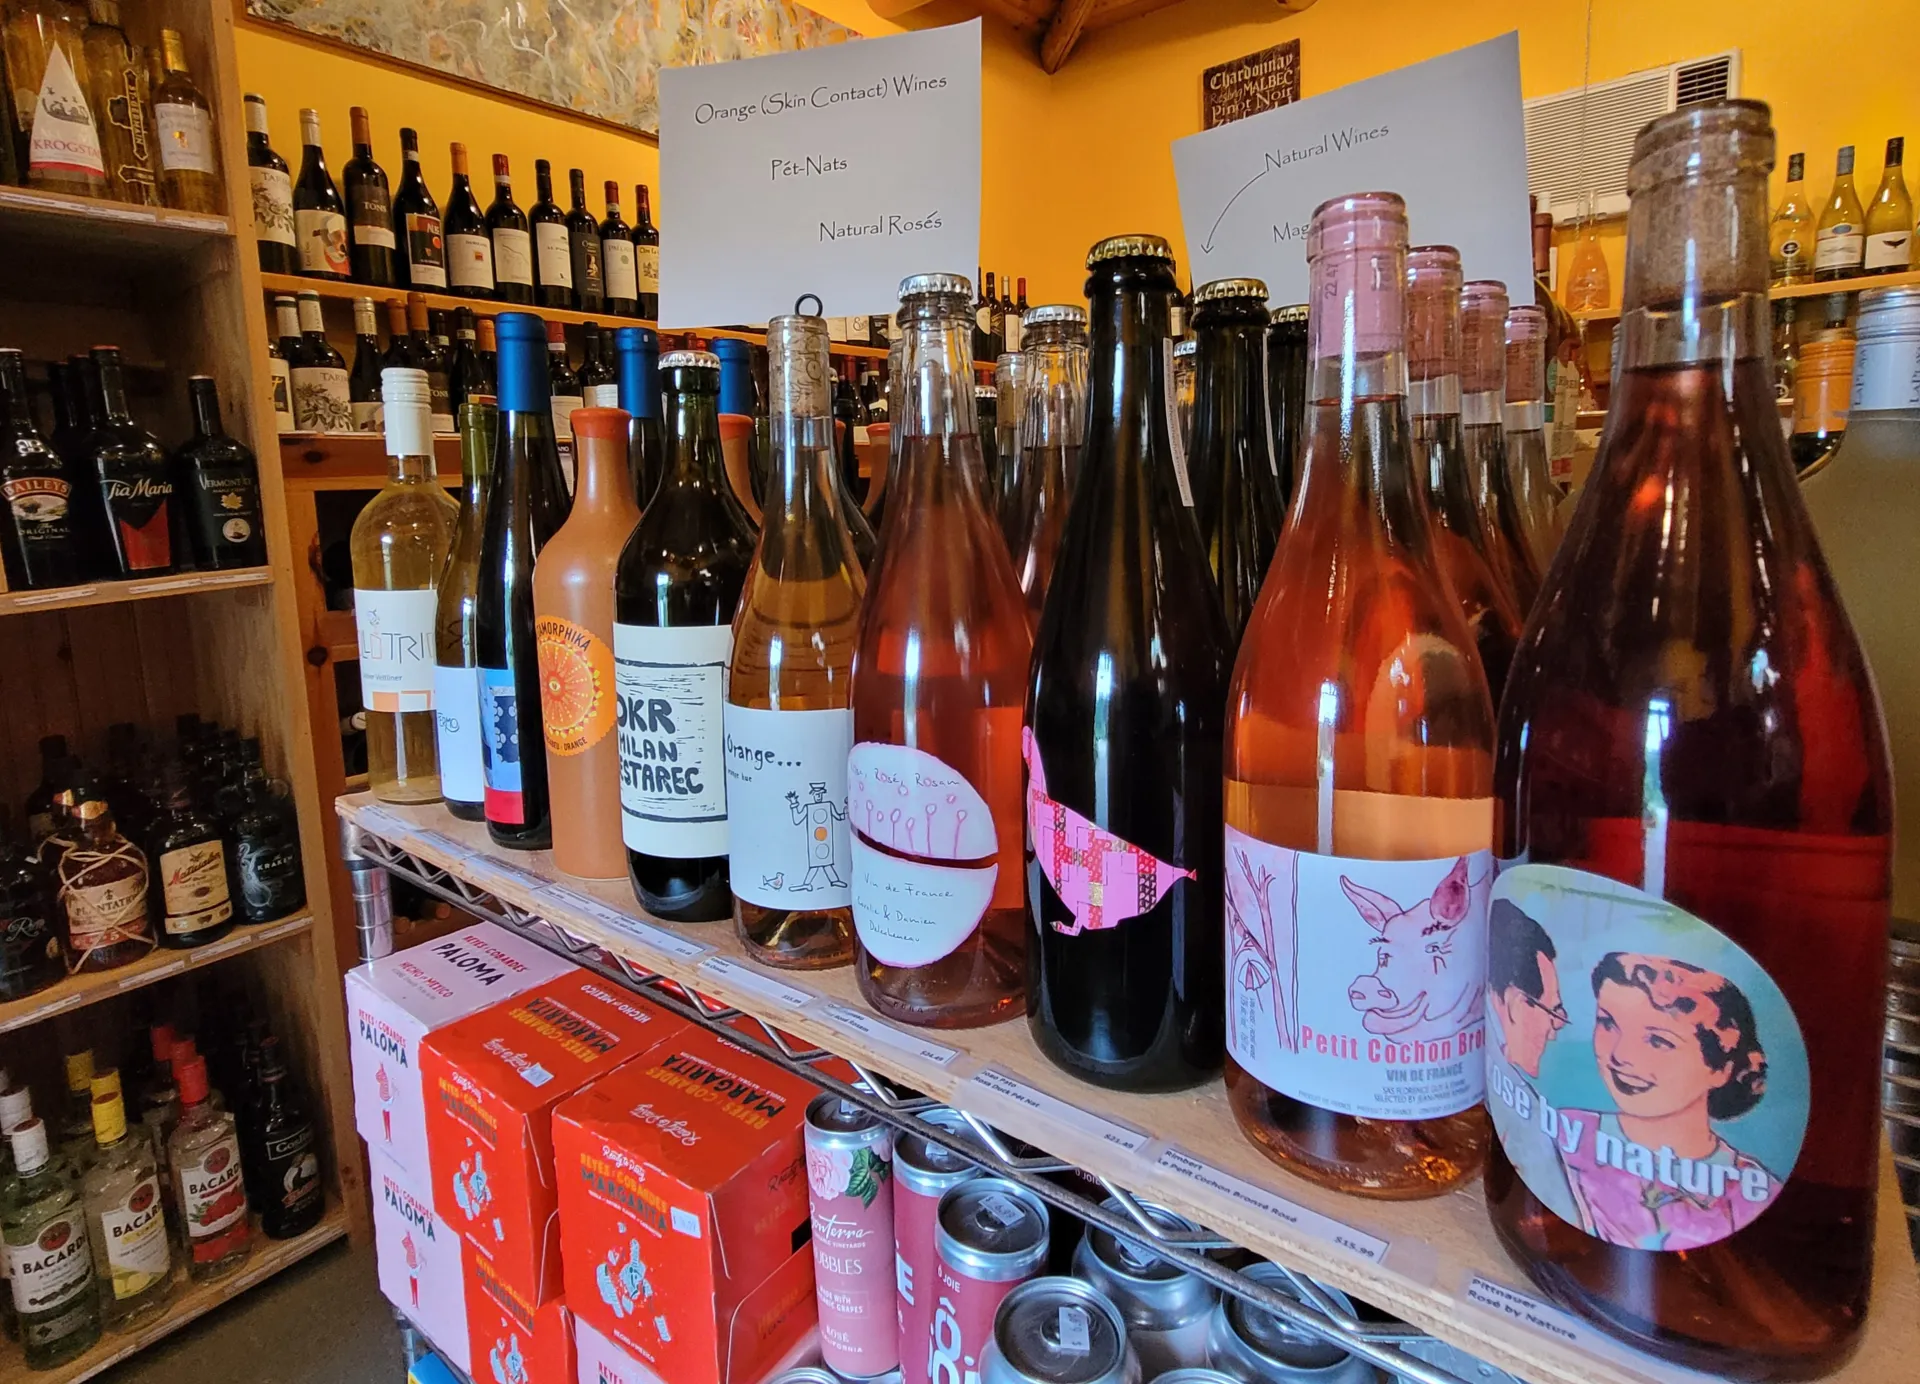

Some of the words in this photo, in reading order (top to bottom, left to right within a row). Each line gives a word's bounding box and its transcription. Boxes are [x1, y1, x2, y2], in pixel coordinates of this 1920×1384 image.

[1210, 53, 1293, 90] Chardonnay
[1243, 69, 1293, 96] MALBEC
[695, 102, 757, 125] Orange
[760, 92, 807, 116] (Skin
[811, 78, 888, 109] Contact)
[893, 74, 947, 98] Wines
[1211, 98, 1252, 125] Pinot
[1255, 87, 1293, 109] Noir
[1265, 135, 1328, 172] Natural
[1332, 124, 1390, 151] Wines
[771, 155, 848, 180] Pét-Nats
[819, 215, 883, 242] Natural
[888, 210, 943, 237] Rosés
[4, 480, 68, 496] BAILEYS
[100, 479, 134, 500] Tia
[128, 477, 173, 500] Maria
[19, 527, 70, 536] ORIGINAL
[616, 691, 676, 735] OKR
[564, 737, 588, 751] ORANGE
[620, 757, 704, 795] STAREC
[257, 855, 293, 871] KRAKEN
[864, 872, 879, 889] Vin
[885, 883, 900, 893] de
[904, 882, 954, 897] France
[882, 904, 892, 921] &
[431, 942, 505, 986] PALOMA
[525, 998, 617, 1053] MARGARITA
[360, 1019, 408, 1068] PALOMA
[1302, 1024, 1359, 1062] Petit
[1367, 1036, 1451, 1065] Cochon
[1457, 1028, 1486, 1056] Bro
[645, 1066, 715, 1102] COBARDES
[661, 1054, 786, 1118] MARGARITA
[999, 1077, 1017, 1089] Pato
[1386, 1066, 1407, 1082] VIN
[1410, 1067, 1424, 1082] DE
[1426, 1062, 1464, 1081] FRANCE
[974, 1075, 991, 1088] Rosa
[991, 1083, 1010, 1096] Duck
[1024, 1097, 1040, 1108] Nat
[722, 1102, 770, 1130] REYES
[1103, 1133, 1134, 1150] $21.49
[1491, 1064, 1531, 1120] osé
[1538, 1094, 1584, 1154] by
[1595, 1128, 1770, 1202] nature
[1164, 1150, 1203, 1170] Rimbert
[581, 1166, 668, 1231] MARGARITA
[1157, 1158, 1168, 1167] Le
[1169, 1162, 1194, 1179] Petit
[1194, 1173, 1231, 1194] Cochon
[1271, 1206, 1298, 1223] Rosé
[384, 1185, 437, 1242] PALOMA
[1334, 1235, 1375, 1258] $15.99
[942, 1274, 961, 1293] JOIE
[1472, 1278, 1537, 1309] Pittnauer
[1468, 1289, 1501, 1309] Rosé
[1504, 1304, 1522, 1318] by
[1525, 1313, 1577, 1340] Nature
